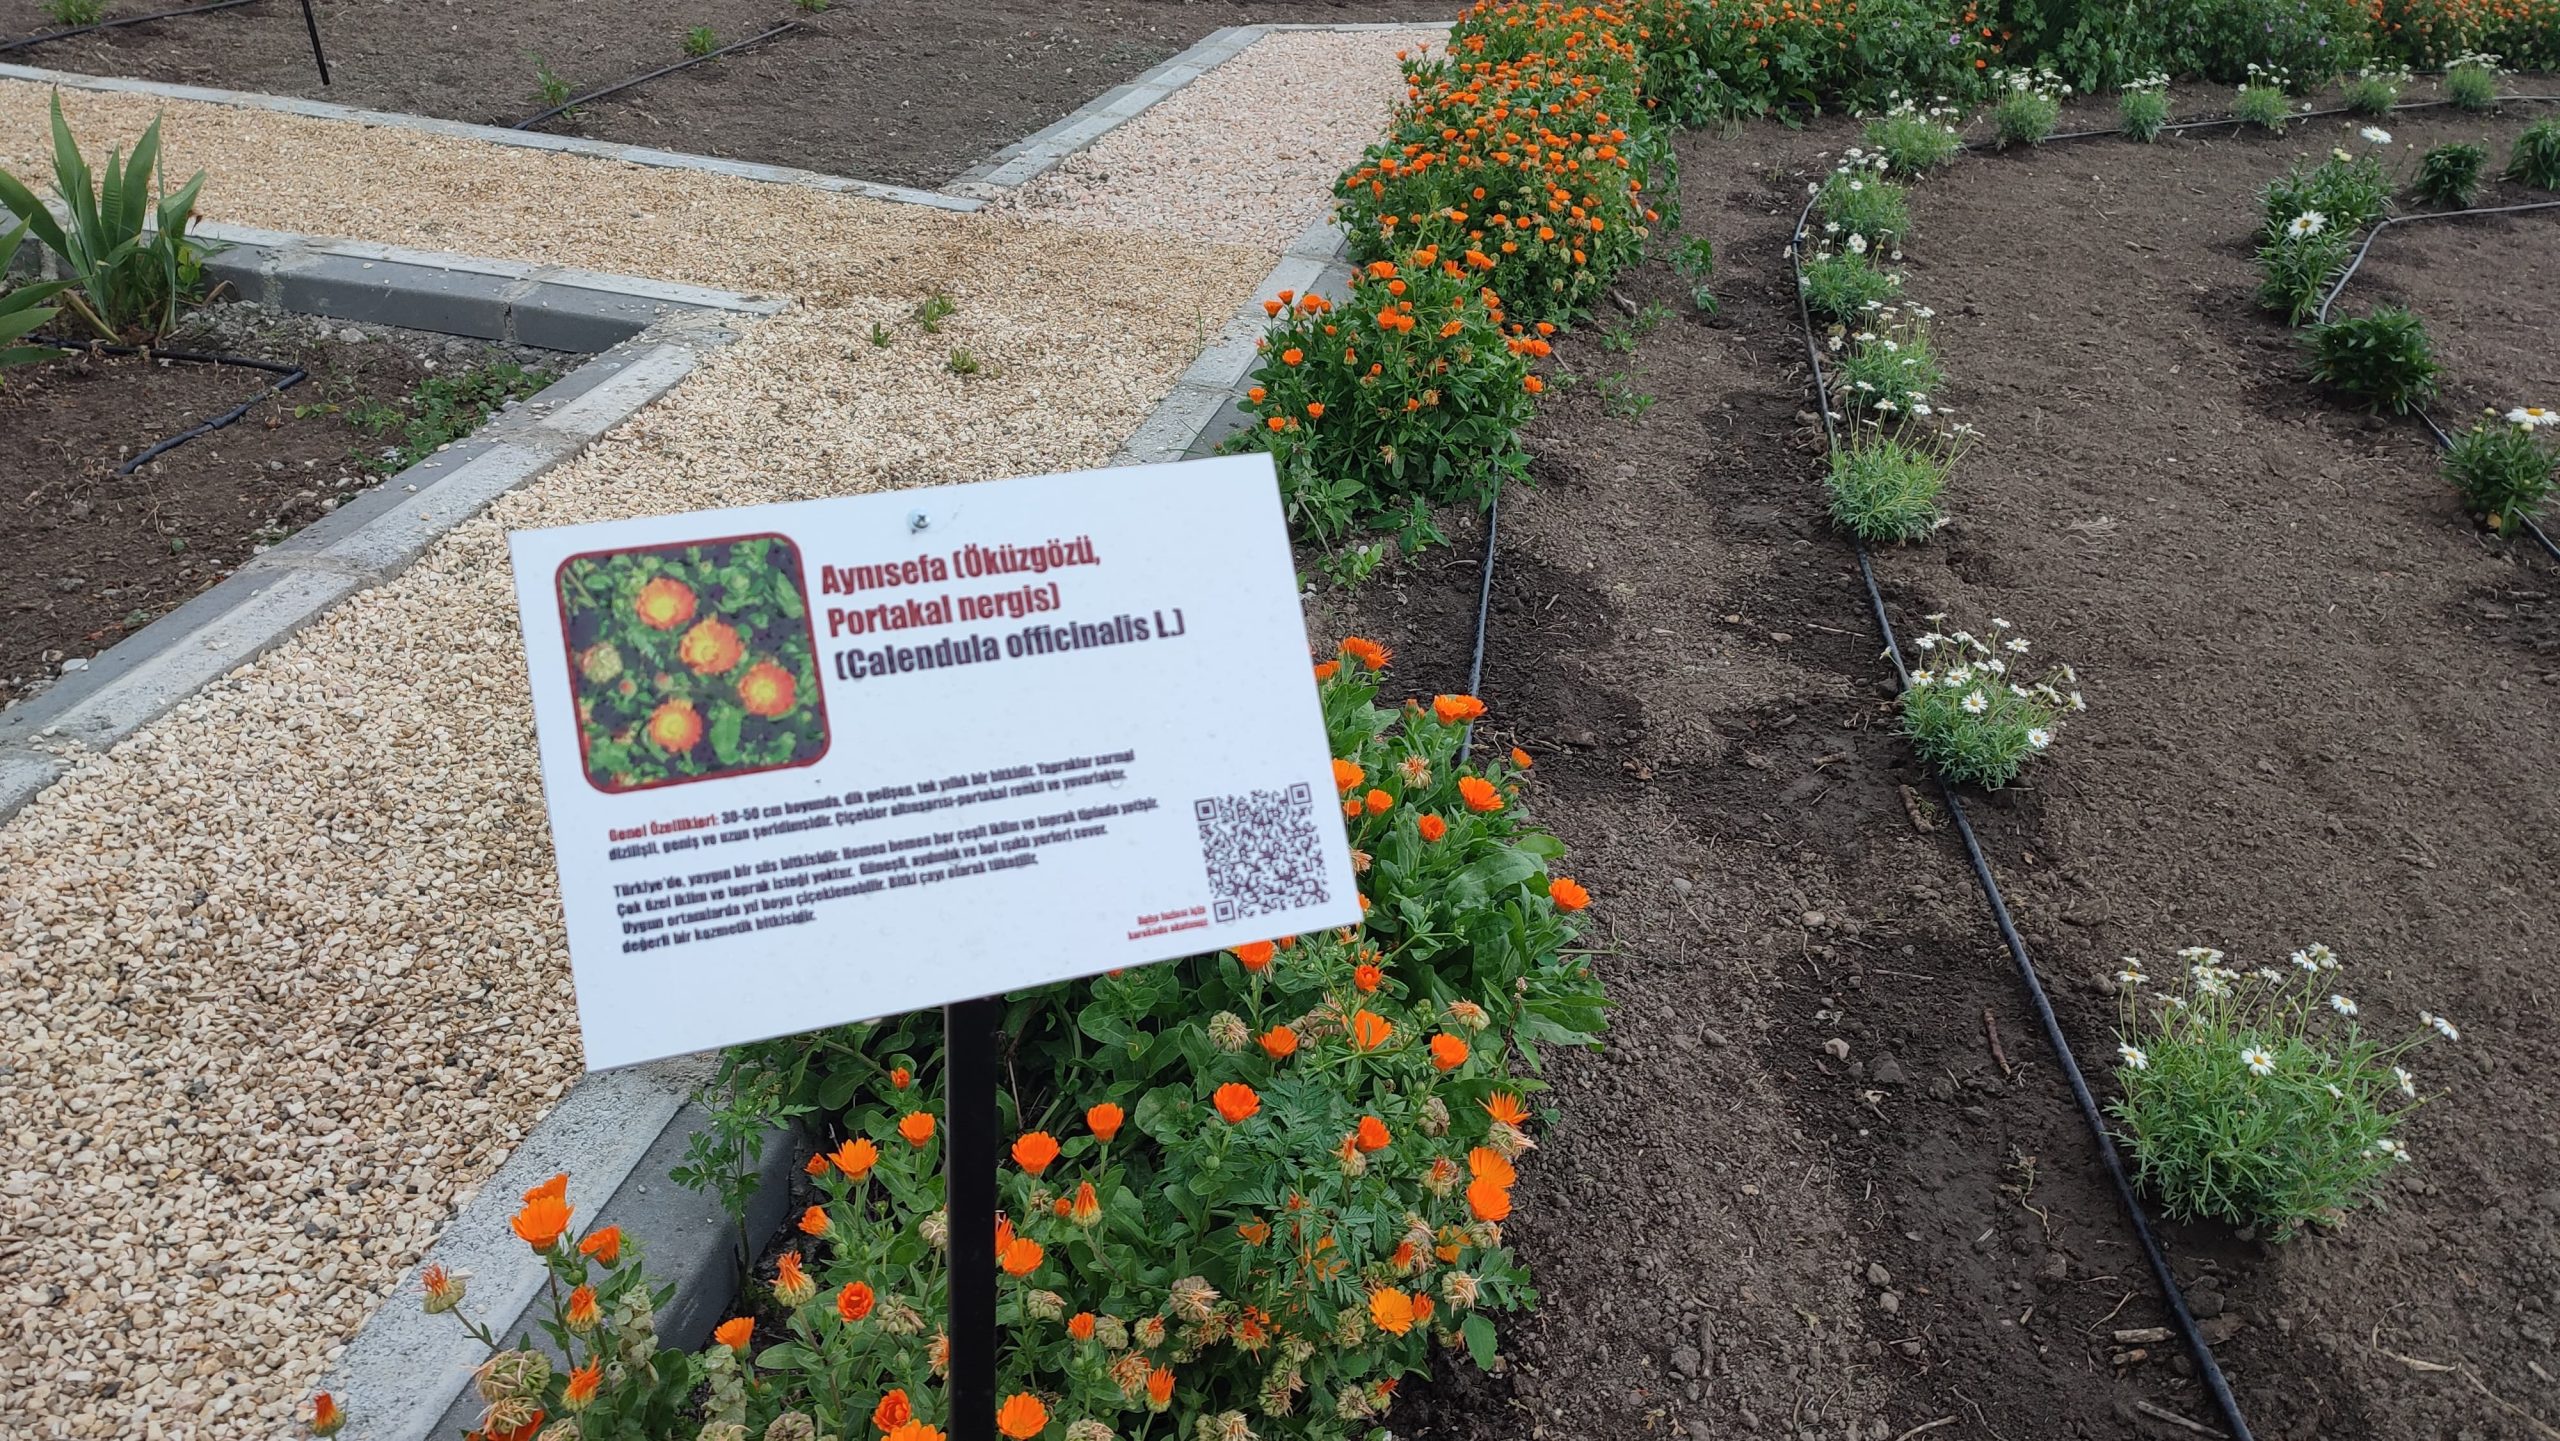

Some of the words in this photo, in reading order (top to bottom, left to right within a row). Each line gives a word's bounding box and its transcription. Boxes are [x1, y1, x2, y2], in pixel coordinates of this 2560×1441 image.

[821, 553, 948, 595] Aynısefa
[952, 534, 1100, 579] (Öküzgözü,
[826, 593, 953, 638] Portakal
[956, 581, 1061, 622] nergis)
[834, 633, 1001, 681] (Calendula
[1005, 613, 1150, 658] officinalis
[1153, 607, 1185, 639] L.)
[608, 823, 647, 842] Genel
[649, 813, 719, 836] Özellikleri:
[762, 805, 783, 818] cm
[843, 790, 864, 806] dik
[916, 779, 937, 794] tek
[970, 771, 988, 785] bir
[661, 835, 699, 853] geniş
[701, 833, 717, 846] ve
[719, 828, 750, 843] uzun
[834, 806, 887, 827] Çiçekler
[1009, 779, 1045, 797] renkli
[1045, 779, 1061, 791] ve
[616, 900, 642, 917] Çok
[644, 894, 671, 911] özel
[673, 890, 708, 907] iklim
[709, 888, 725, 901] ve
[726, 879, 770, 897] toprak
[771, 871, 810, 890] isteği
[961, 845, 977, 858] ve
[978, 839, 999, 855] bol
[687, 868, 731, 887] yaygın
[733, 863, 751, 878] bir
[754, 860, 778, 875] süs
[841, 843, 887, 860] Hemen
[887, 835, 932, 853] hemen
[932, 831, 954, 846] her
[988, 820, 1020, 836] iklim
[1020, 818, 1036, 830] ve
[1036, 810, 1076, 827] toprak
[621, 917, 664, 934] Uygun
[666, 903, 741, 927] ortamlarda
[742, 898, 759, 915] yıl
[760, 895, 793, 910] boyu
[887, 871, 918, 889] Bitki
[918, 869, 945, 885] çayı
[946, 860, 986, 878] olarak
[621, 933, 670, 954] değerli
[672, 929, 691, 944] bir
[693, 919, 753, 941] kozmetik
